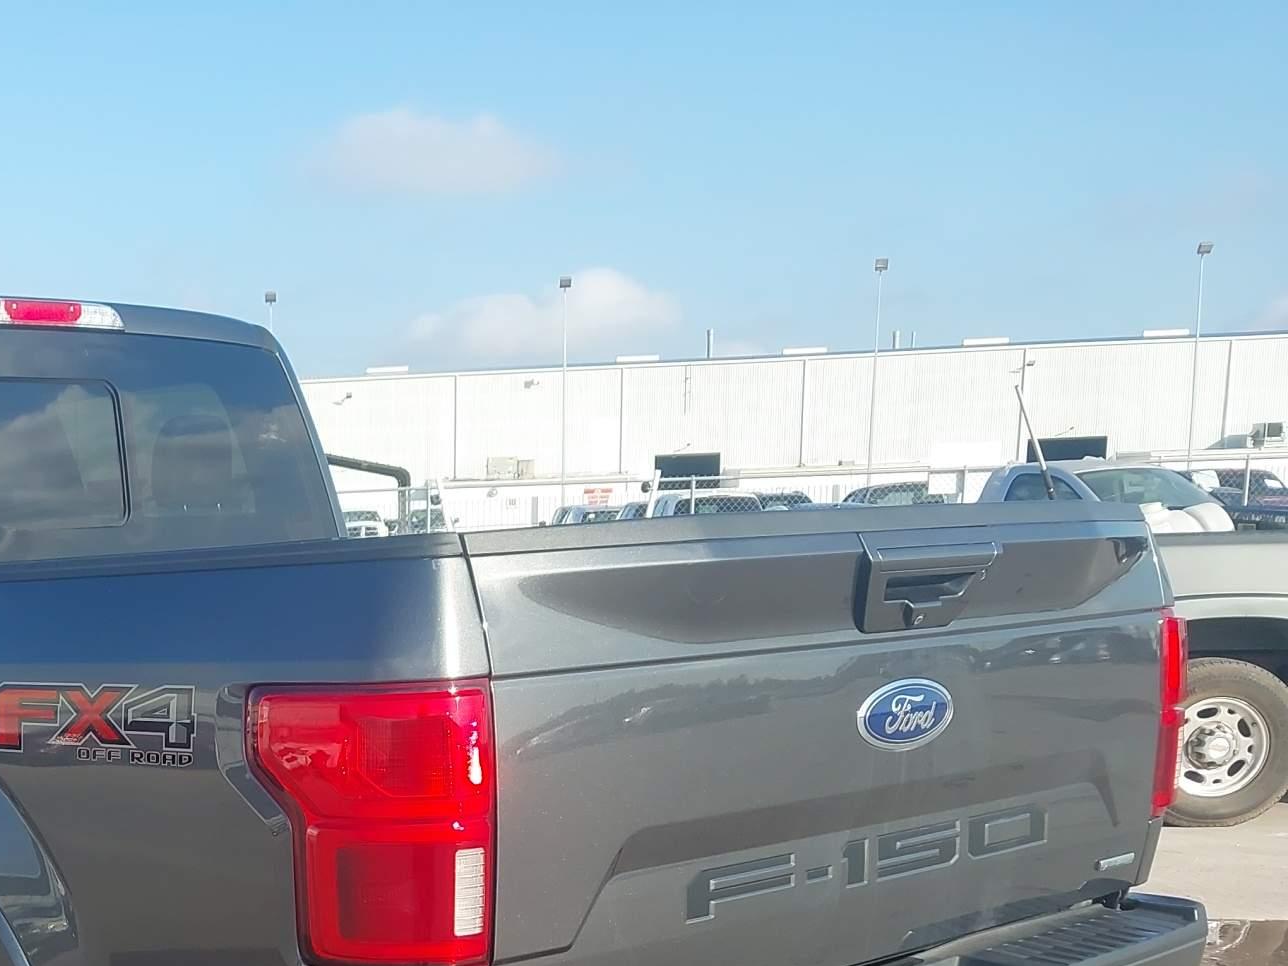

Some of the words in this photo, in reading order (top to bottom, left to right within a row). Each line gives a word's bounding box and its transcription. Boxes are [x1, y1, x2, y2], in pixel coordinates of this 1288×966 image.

[884, 694, 937, 734] Ford
[76, 747, 122, 762] OFF
[129, 750, 194, 767] ROAD
[686, 803, 1048, 924] F-150
